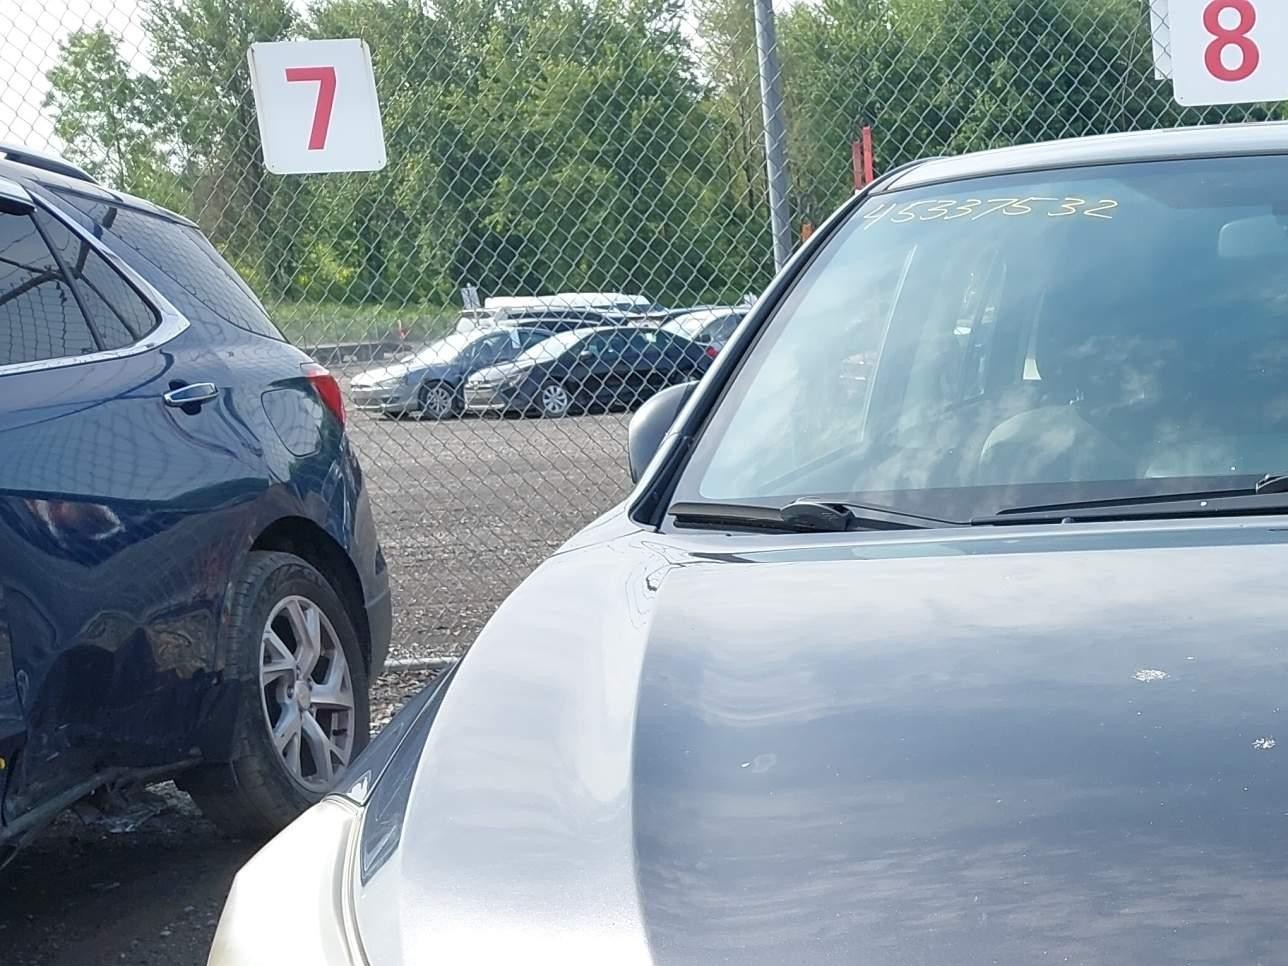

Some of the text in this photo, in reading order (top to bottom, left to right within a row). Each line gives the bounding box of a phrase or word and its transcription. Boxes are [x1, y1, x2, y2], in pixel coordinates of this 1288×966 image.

[1203, 0, 1259, 82] 8
[286, 67, 336, 149] 7
[863, 197, 1118, 230] 45337532
